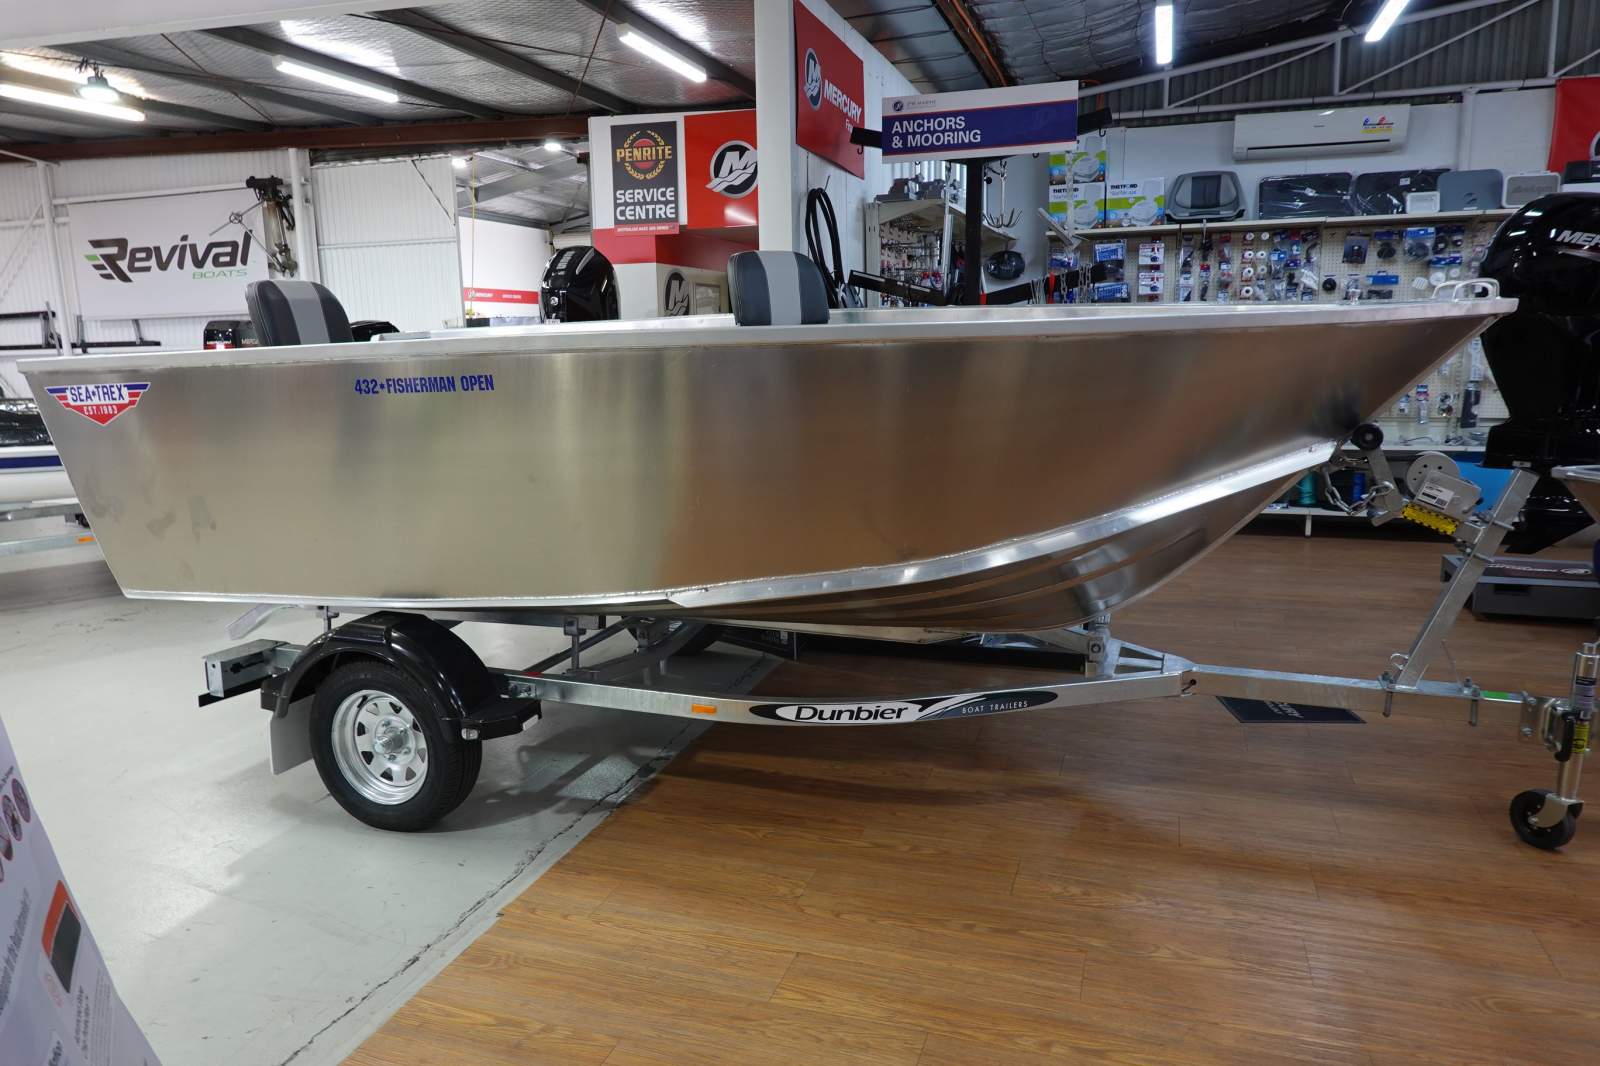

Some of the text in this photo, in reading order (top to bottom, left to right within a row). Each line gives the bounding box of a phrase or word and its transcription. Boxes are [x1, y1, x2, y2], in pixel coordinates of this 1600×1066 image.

[823, 79, 863, 124] MERCURY
[892, 116, 966, 134] ANCHORS
[891, 130, 981, 149] & MOORING
[616, 145, 673, 162] PENRITE
[616, 187, 675, 204] SERVICE
[616, 204, 676, 221] CENTRE
[87, 229, 253, 283] Revival
[192, 268, 248, 280] BOATS
[354, 374, 495, 395] 432 FISHERMAN OPEN
[794, 700, 1028, 721] Dunbier BOAT TRAILERS
